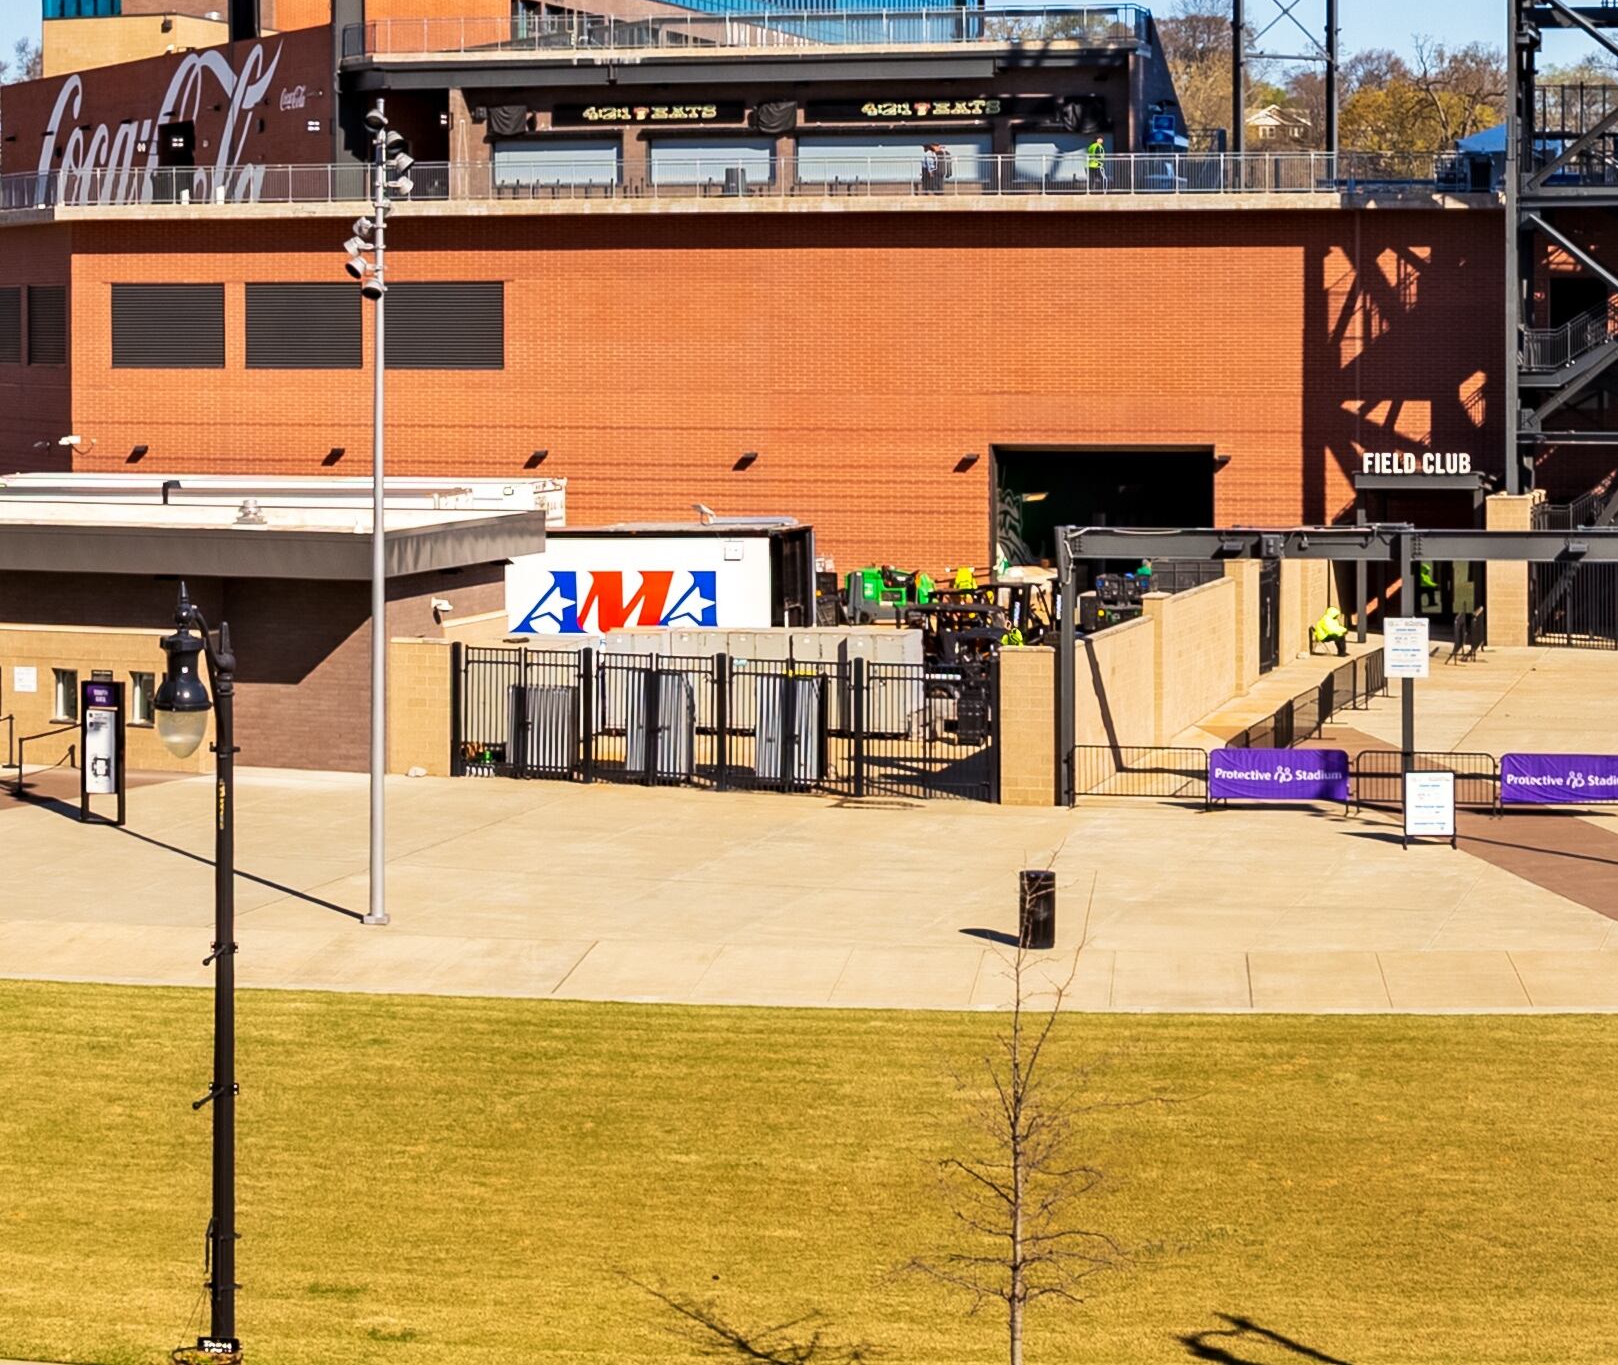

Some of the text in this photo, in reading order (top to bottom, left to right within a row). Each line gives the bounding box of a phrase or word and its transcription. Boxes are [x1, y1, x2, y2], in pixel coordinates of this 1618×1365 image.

[650, 104, 717, 120] EATS
[1362, 452, 1472, 474] FIELD CLUB
[509, 570, 719, 634] AMA
[1214, 767, 1343, 782] Protective Stadium
[1505, 773, 1564, 787] Protective
